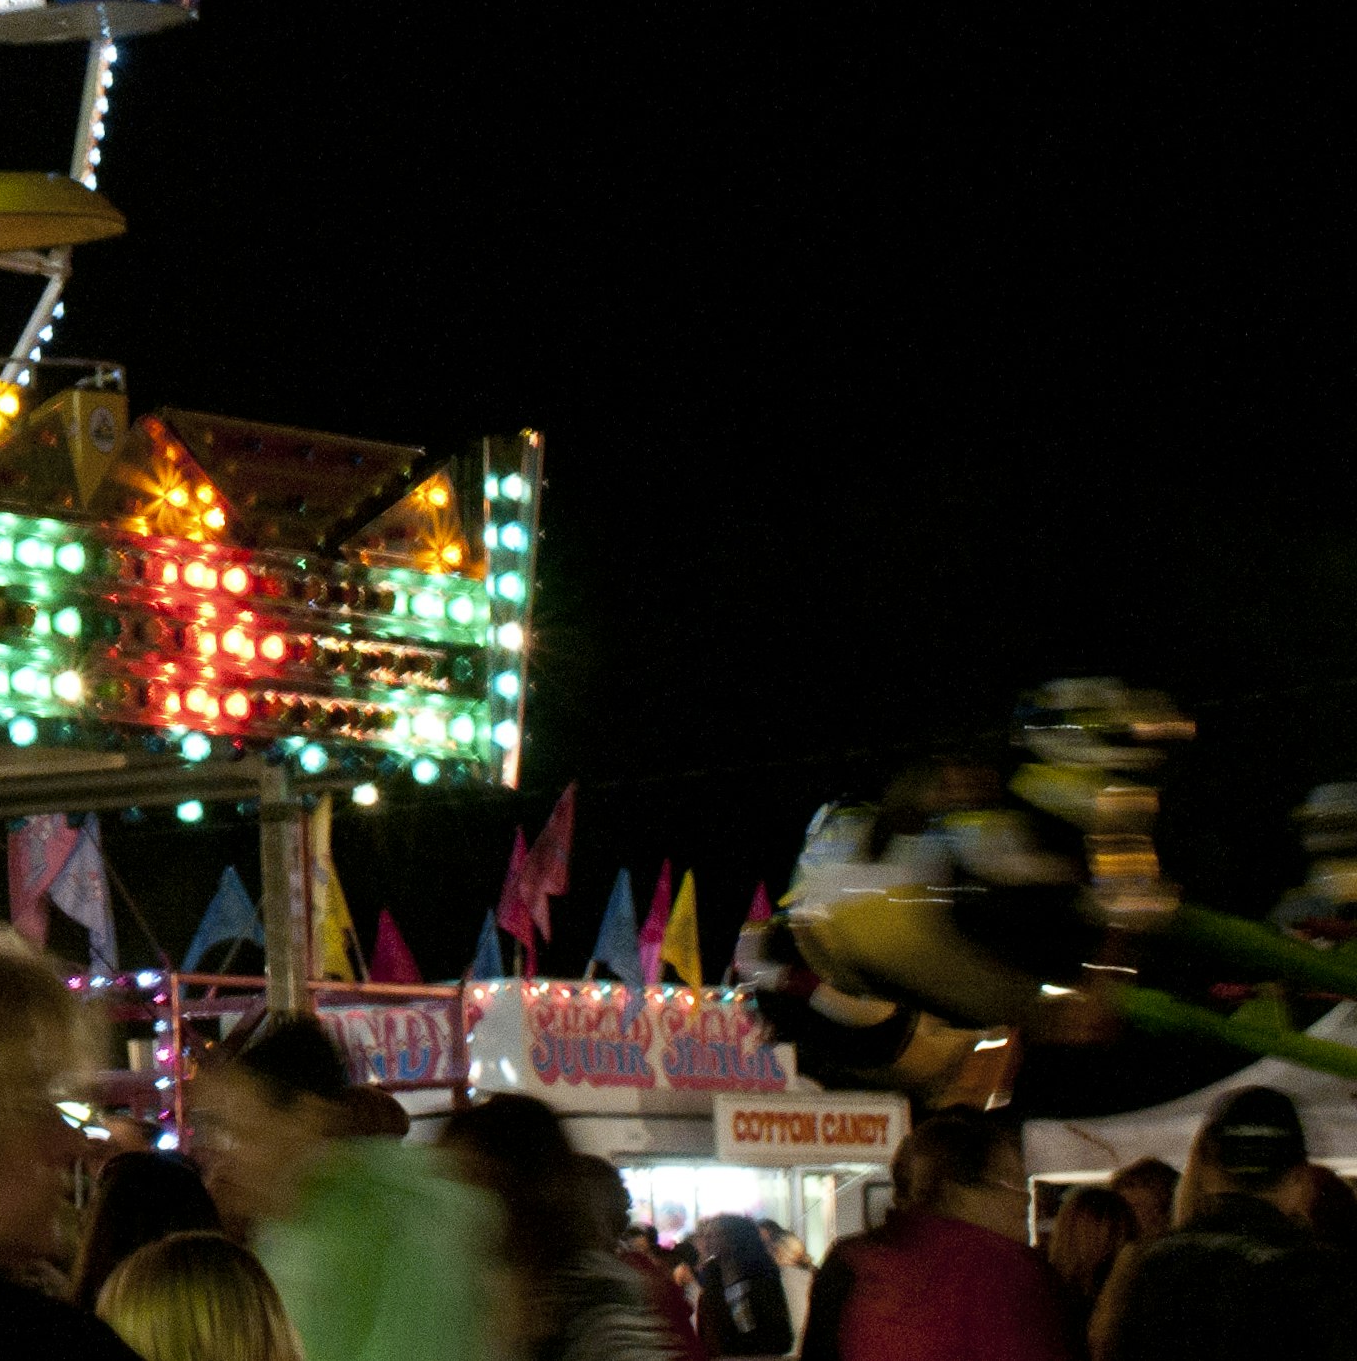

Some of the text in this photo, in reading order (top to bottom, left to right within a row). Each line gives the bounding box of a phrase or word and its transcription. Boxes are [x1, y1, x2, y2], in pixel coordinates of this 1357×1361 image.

[530, 1001, 656, 1088] SUGAR
[733, 1111, 889, 1145] COTTON CANDY
